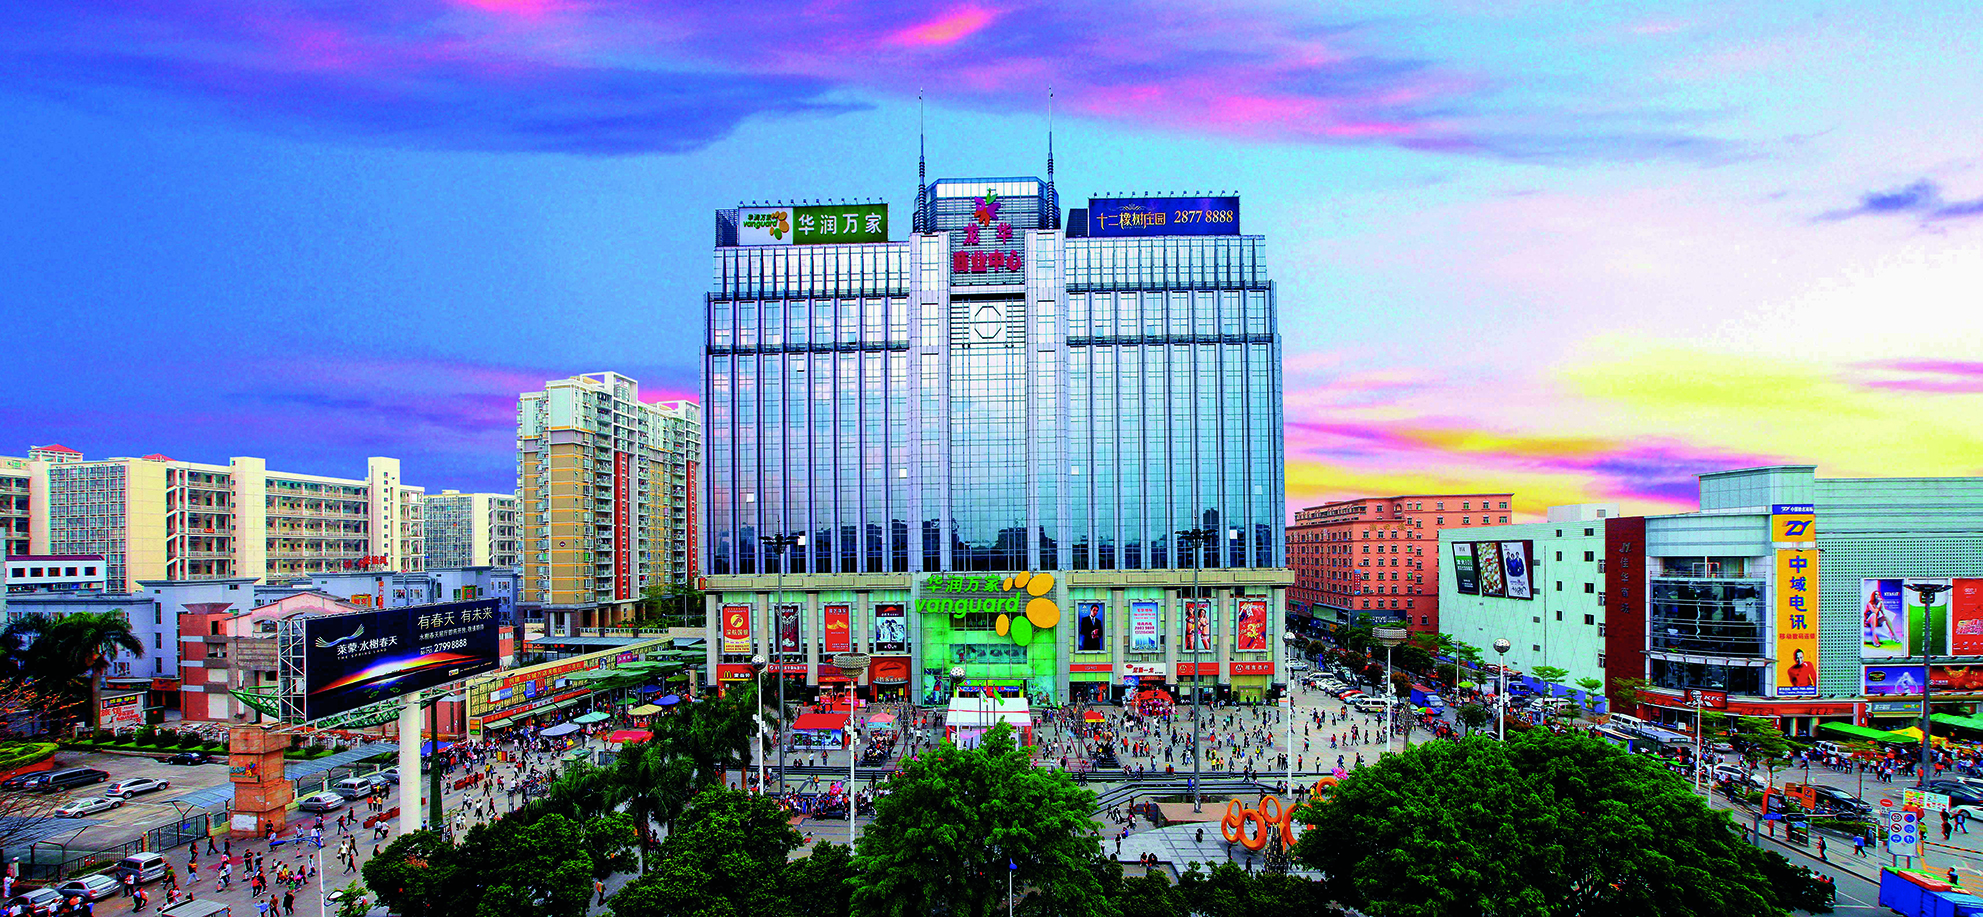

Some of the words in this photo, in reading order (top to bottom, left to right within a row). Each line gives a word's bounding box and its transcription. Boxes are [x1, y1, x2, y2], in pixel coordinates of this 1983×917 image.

[743, 219, 778, 229] vanguard
[798, 212, 882, 236] 华润万家
[1096, 211, 1166, 230] 十二橡树庄园
[1174, 210, 1202, 223] 2877
[1205, 210, 1234, 223] 8888
[963, 222, 1013, 245] 龙华
[953, 249, 1022, 272] 商业中心
[926, 573, 1001, 593] 华润万家
[1789, 555, 1809, 630] 中域电讯
[914, 591, 1021, 619] vanguard
[417, 611, 455, 630] 有春天
[460, 606, 493, 623] 有未来
